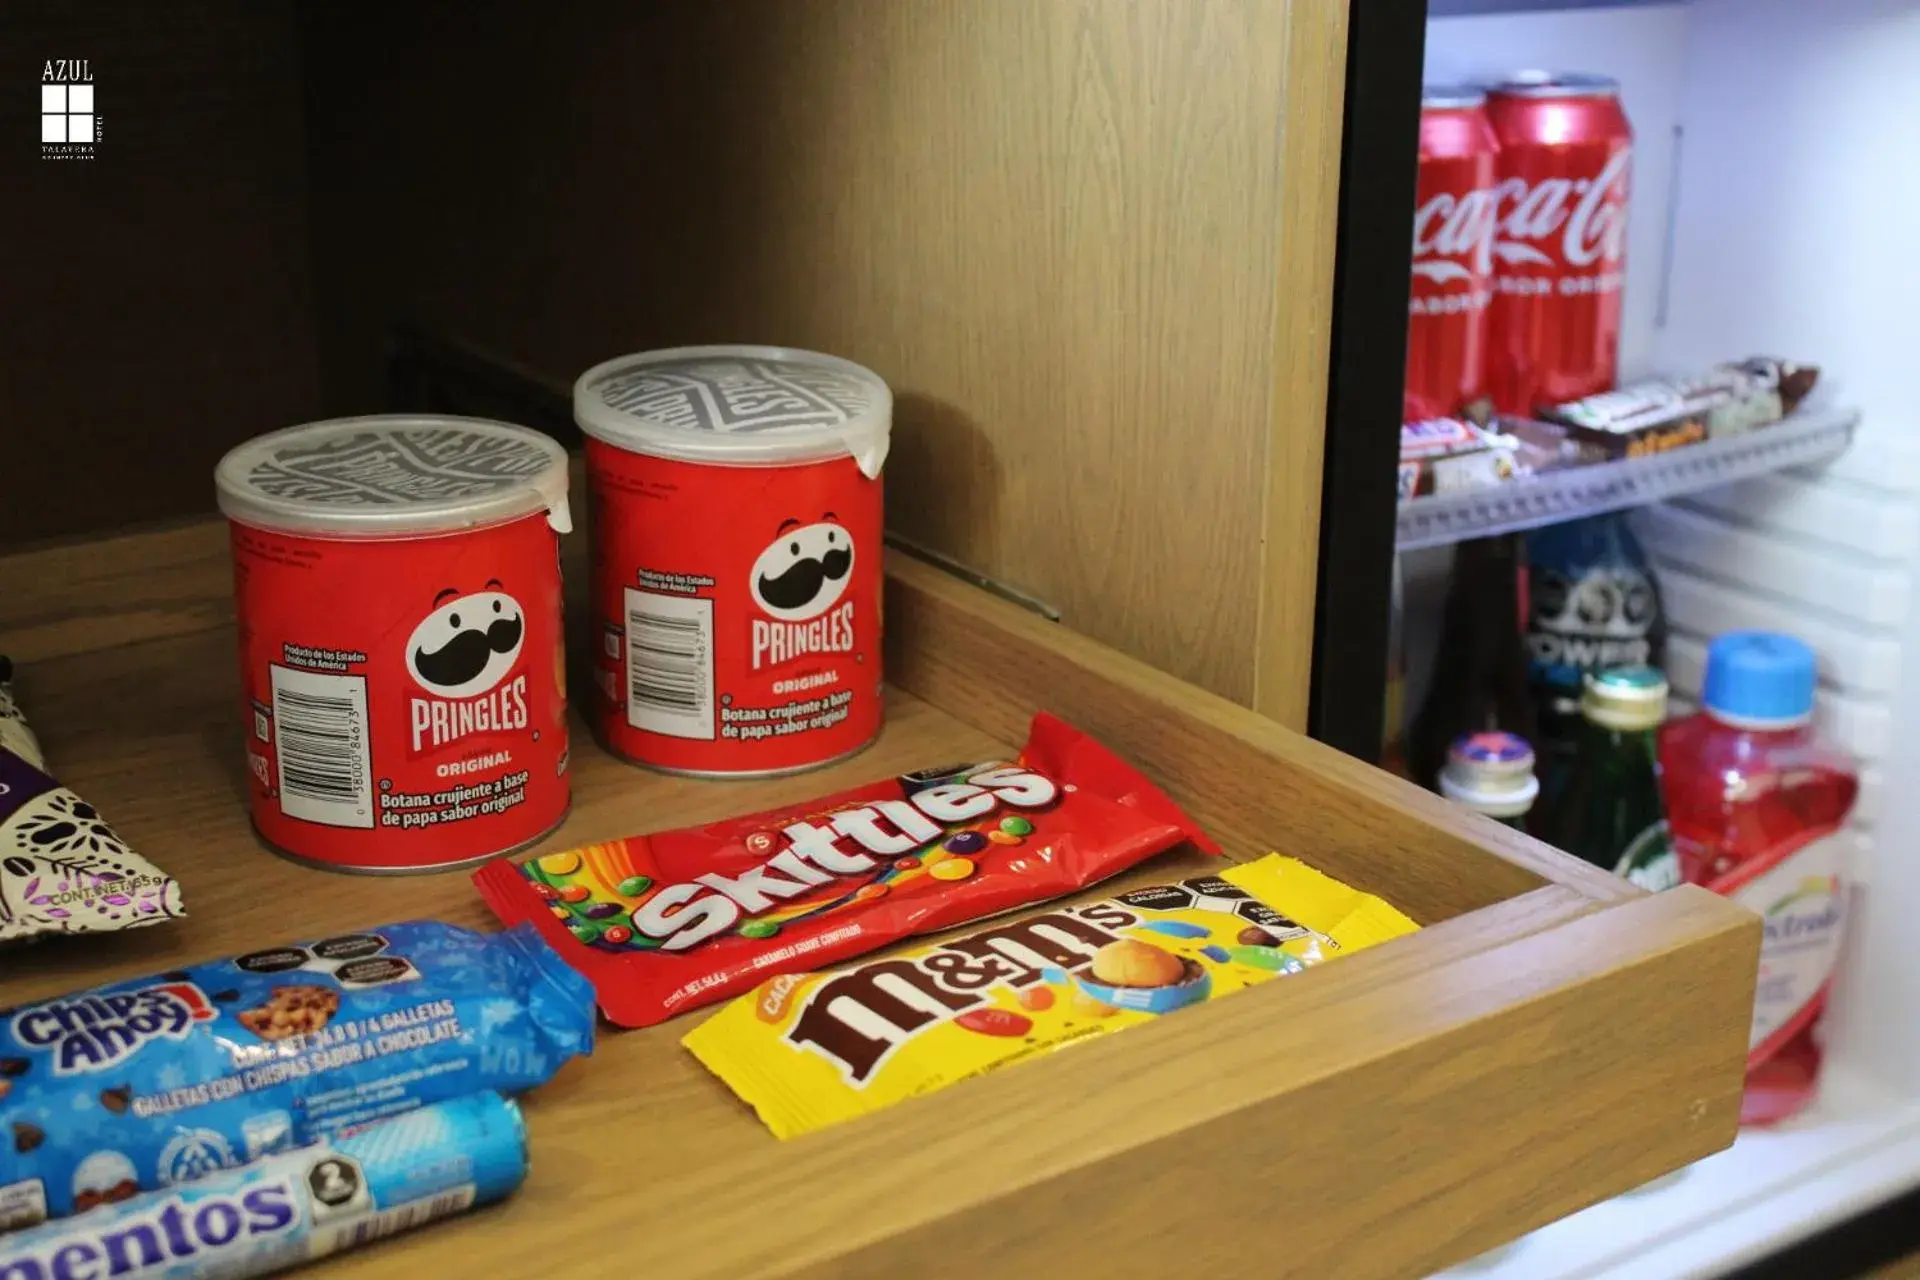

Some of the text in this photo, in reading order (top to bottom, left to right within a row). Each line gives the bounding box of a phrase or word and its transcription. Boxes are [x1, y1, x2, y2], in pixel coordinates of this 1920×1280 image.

[753, 600, 853, 670] PRINGLES
[1528, 634, 1651, 668] OWER
[313, 649, 322, 659] de
[323, 649, 335, 660] los
[336, 651, 366, 662] Estados
[318, 659, 347, 671] América
[773, 670, 839, 694] ORIGINAL
[411, 675, 527, 752] PRINGLES
[722, 709, 767, 722] Botana
[769, 700, 821, 723] crujiente
[822, 697, 829, 708] a
[722, 705, 848, 740] de papa sabor original
[436, 751, 513, 778] ORIGINAL
[381, 771, 529, 809] Botana crujiente a base
[382, 788, 525, 828] de papa sabor original
[631, 767, 1057, 951] Skittles
[380, 999, 456, 1030] GALLETAS
[132, 1081, 212, 1119] GALLETAS
[213, 1073, 245, 1102] CON
[245, 1056, 311, 1092] CHISPAS
[311, 1044, 364, 1075] SABOR
[363, 1041, 376, 1061] A
[376, 1018, 462, 1055] CHOCOLATE
